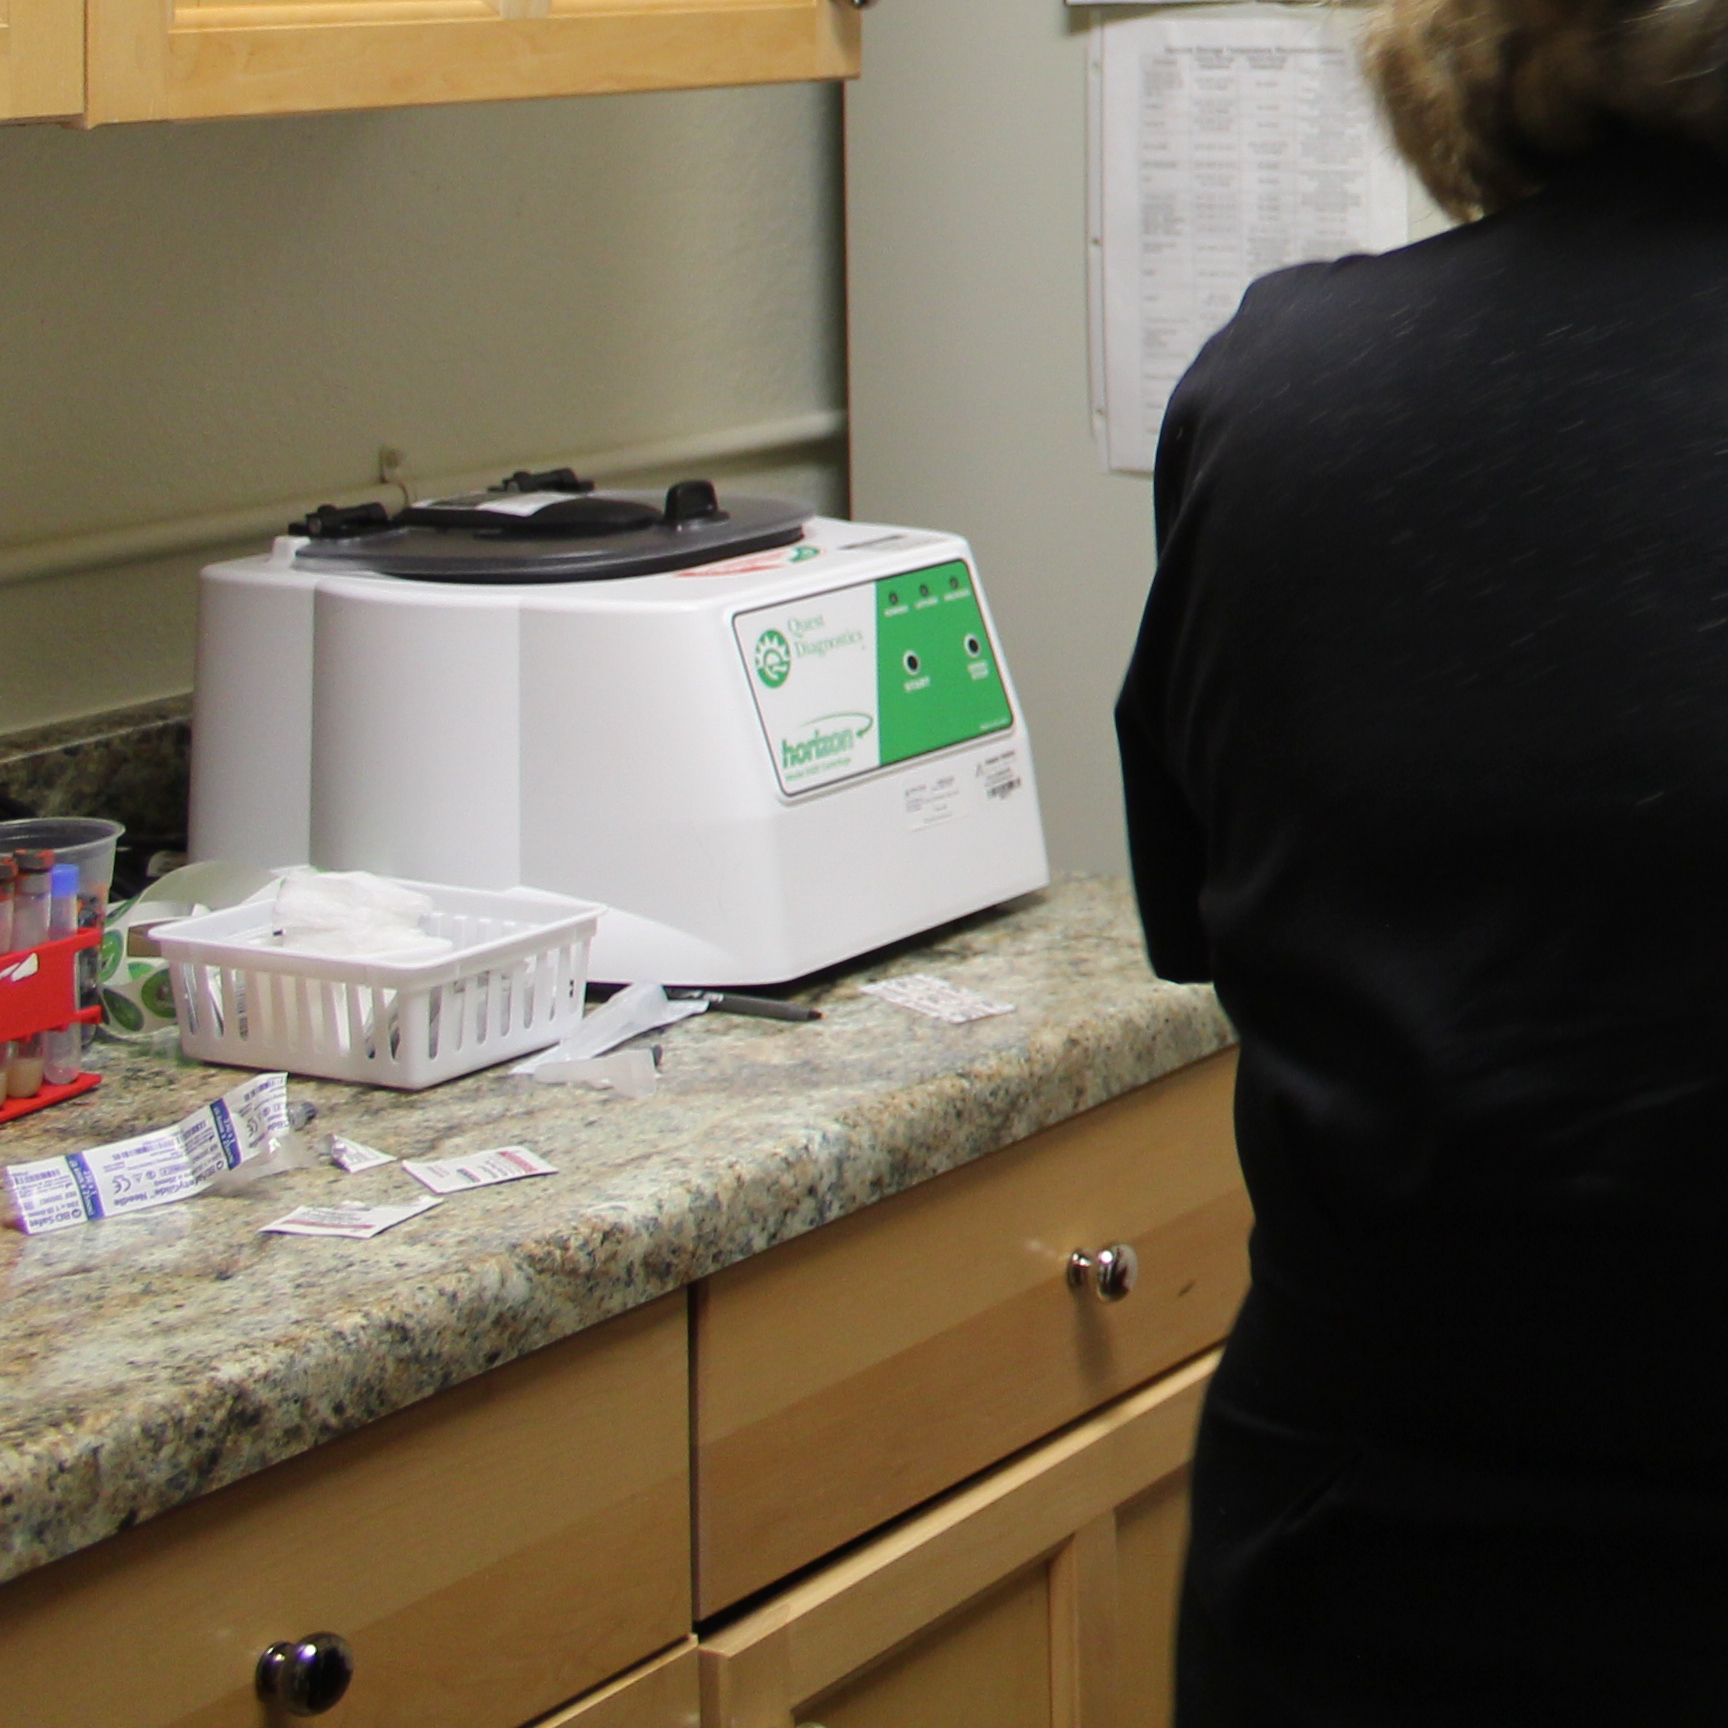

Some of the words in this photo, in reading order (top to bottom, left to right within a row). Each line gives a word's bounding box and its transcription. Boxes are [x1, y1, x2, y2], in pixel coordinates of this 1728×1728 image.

[787, 615, 825, 638] Quest
[795, 630, 863, 658] Diagnostics
[781, 729, 855, 768] horizon
[113, 1191, 148, 1206] Needle
[55, 1211, 71, 1223] BD
